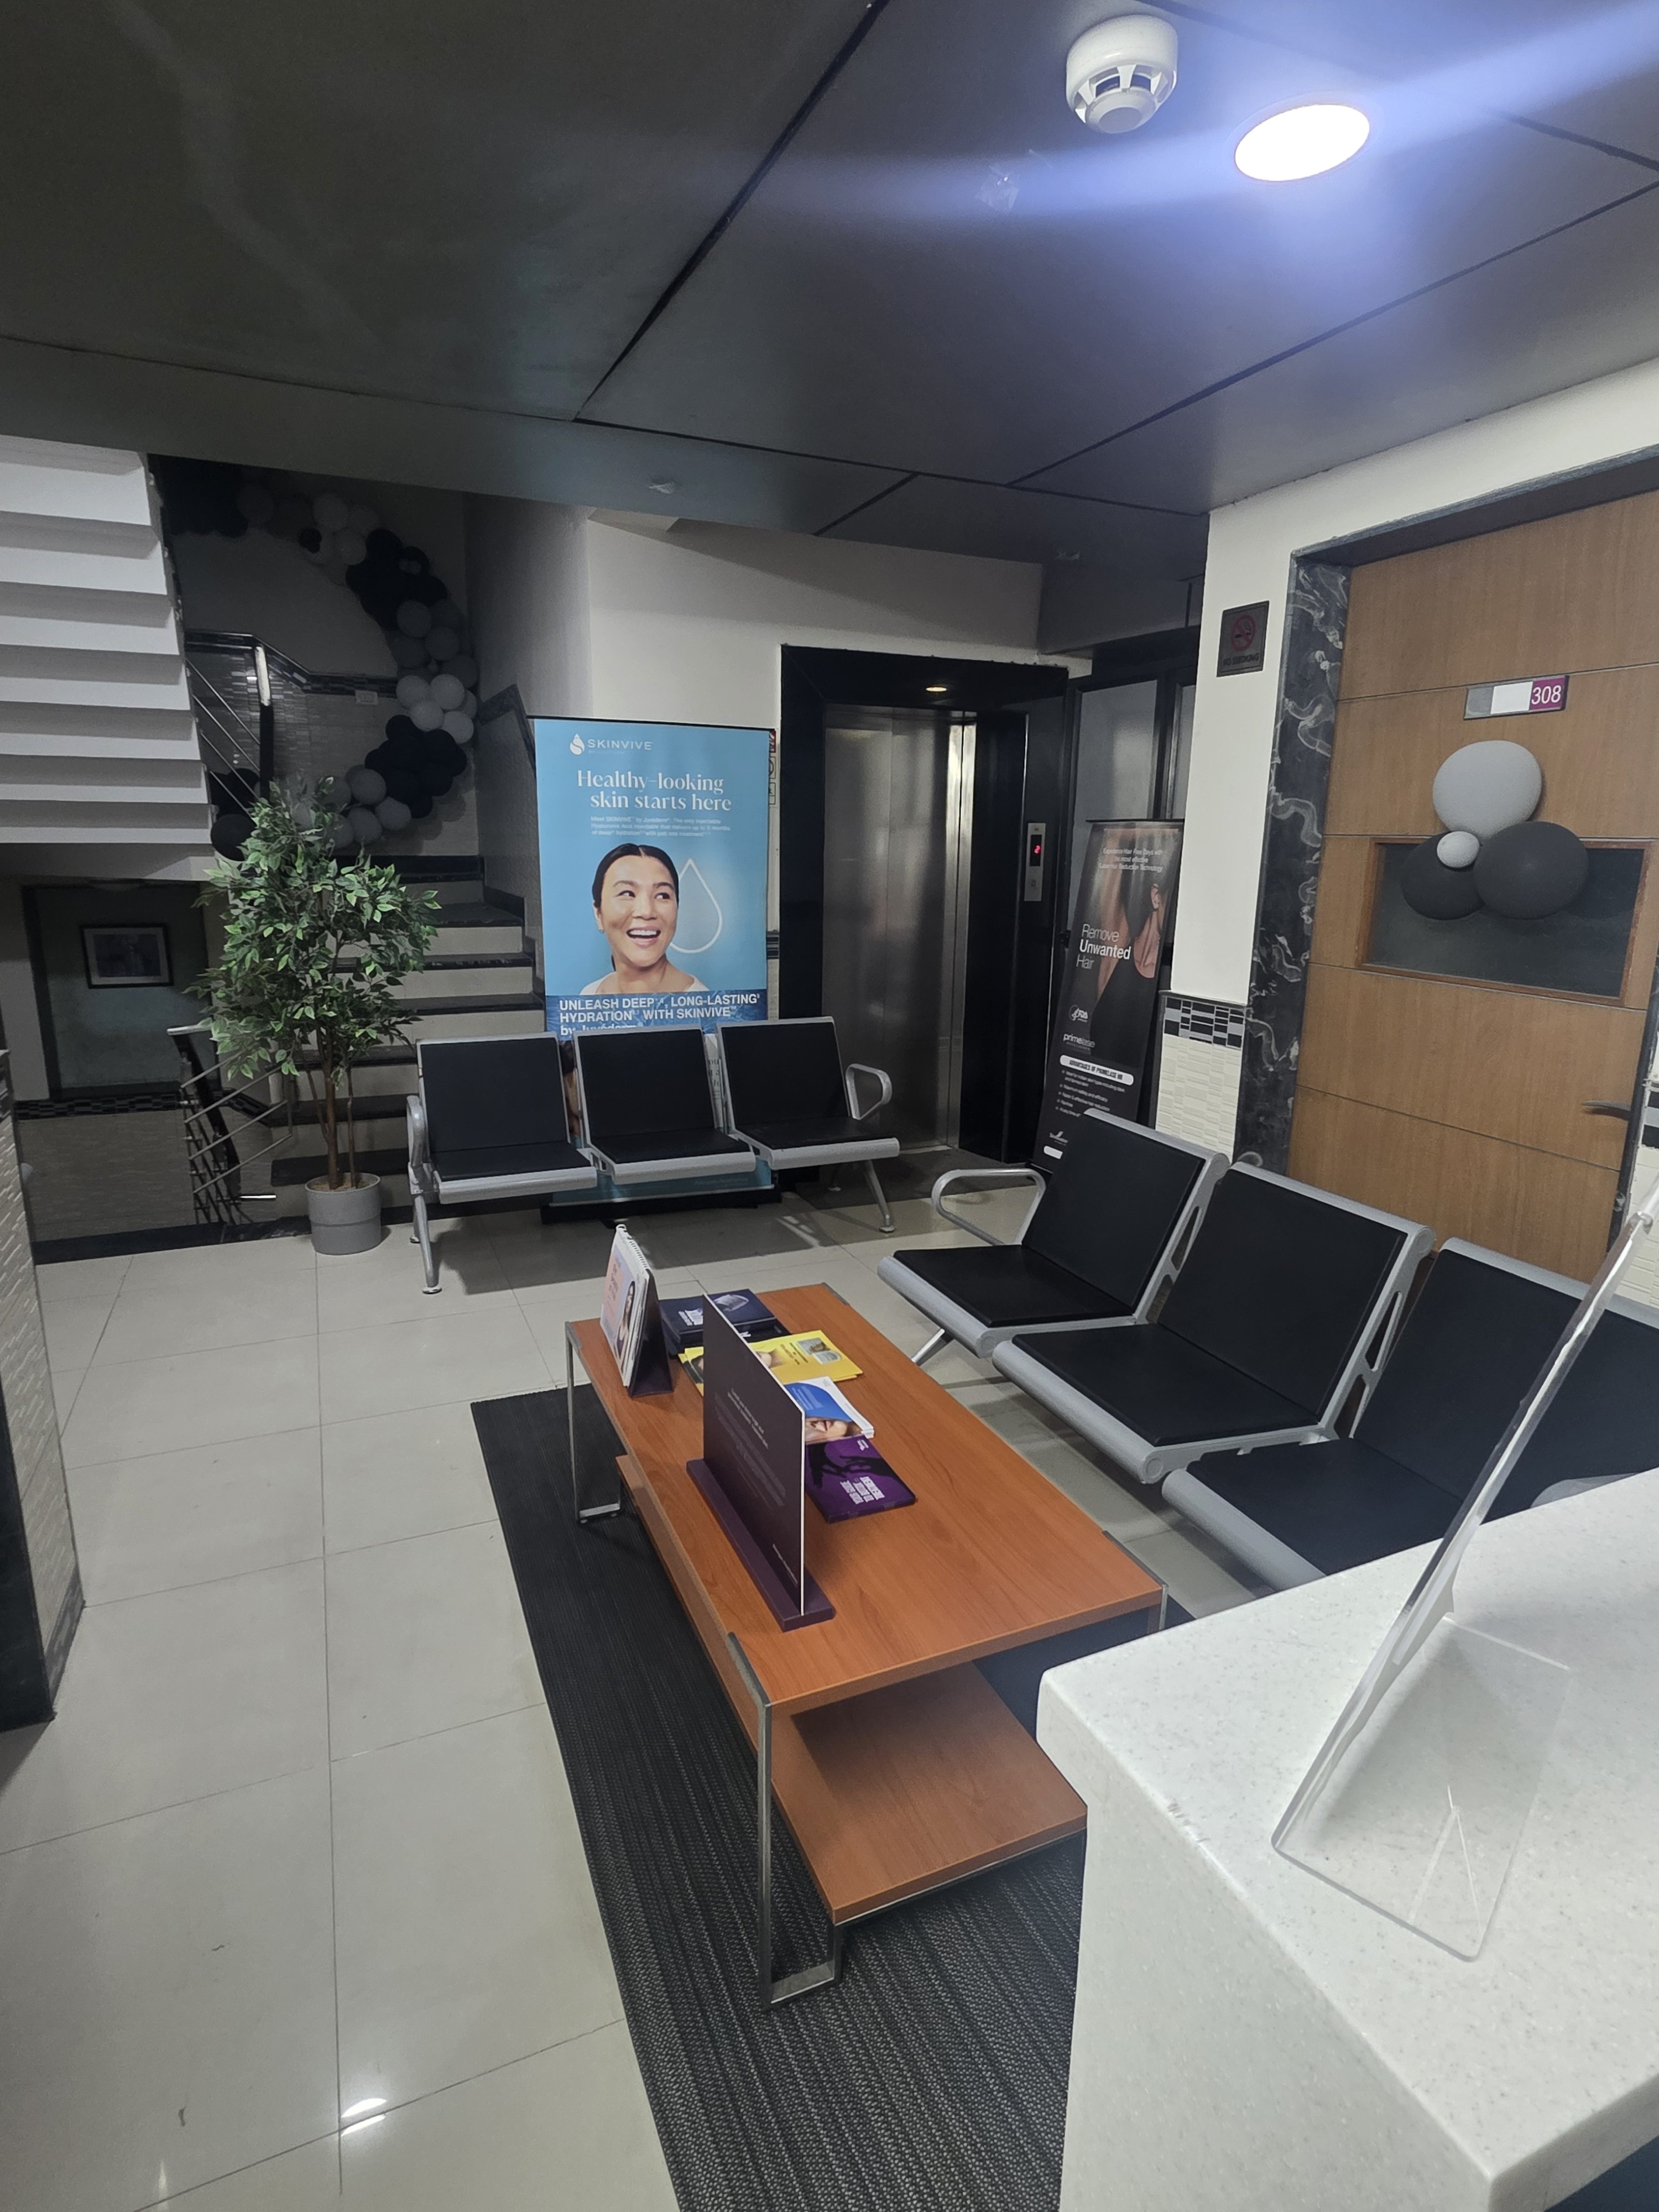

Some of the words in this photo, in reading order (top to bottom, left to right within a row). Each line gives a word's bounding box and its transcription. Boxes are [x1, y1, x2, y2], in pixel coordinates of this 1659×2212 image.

[1531, 685, 1562, 705] 308
[577, 769, 724, 795] Healthy-looking
[590, 790, 629, 808] skin
[634, 795, 686, 810] starts
[692, 793, 732, 811] here
[1082, 924, 1119, 942] Remove
[1079, 939, 1131, 959] Unwanted
[1076, 954, 1094, 969] Hair
[559, 998, 619, 1010] UNLEASH
[643, 1009, 673, 1020] WITH
